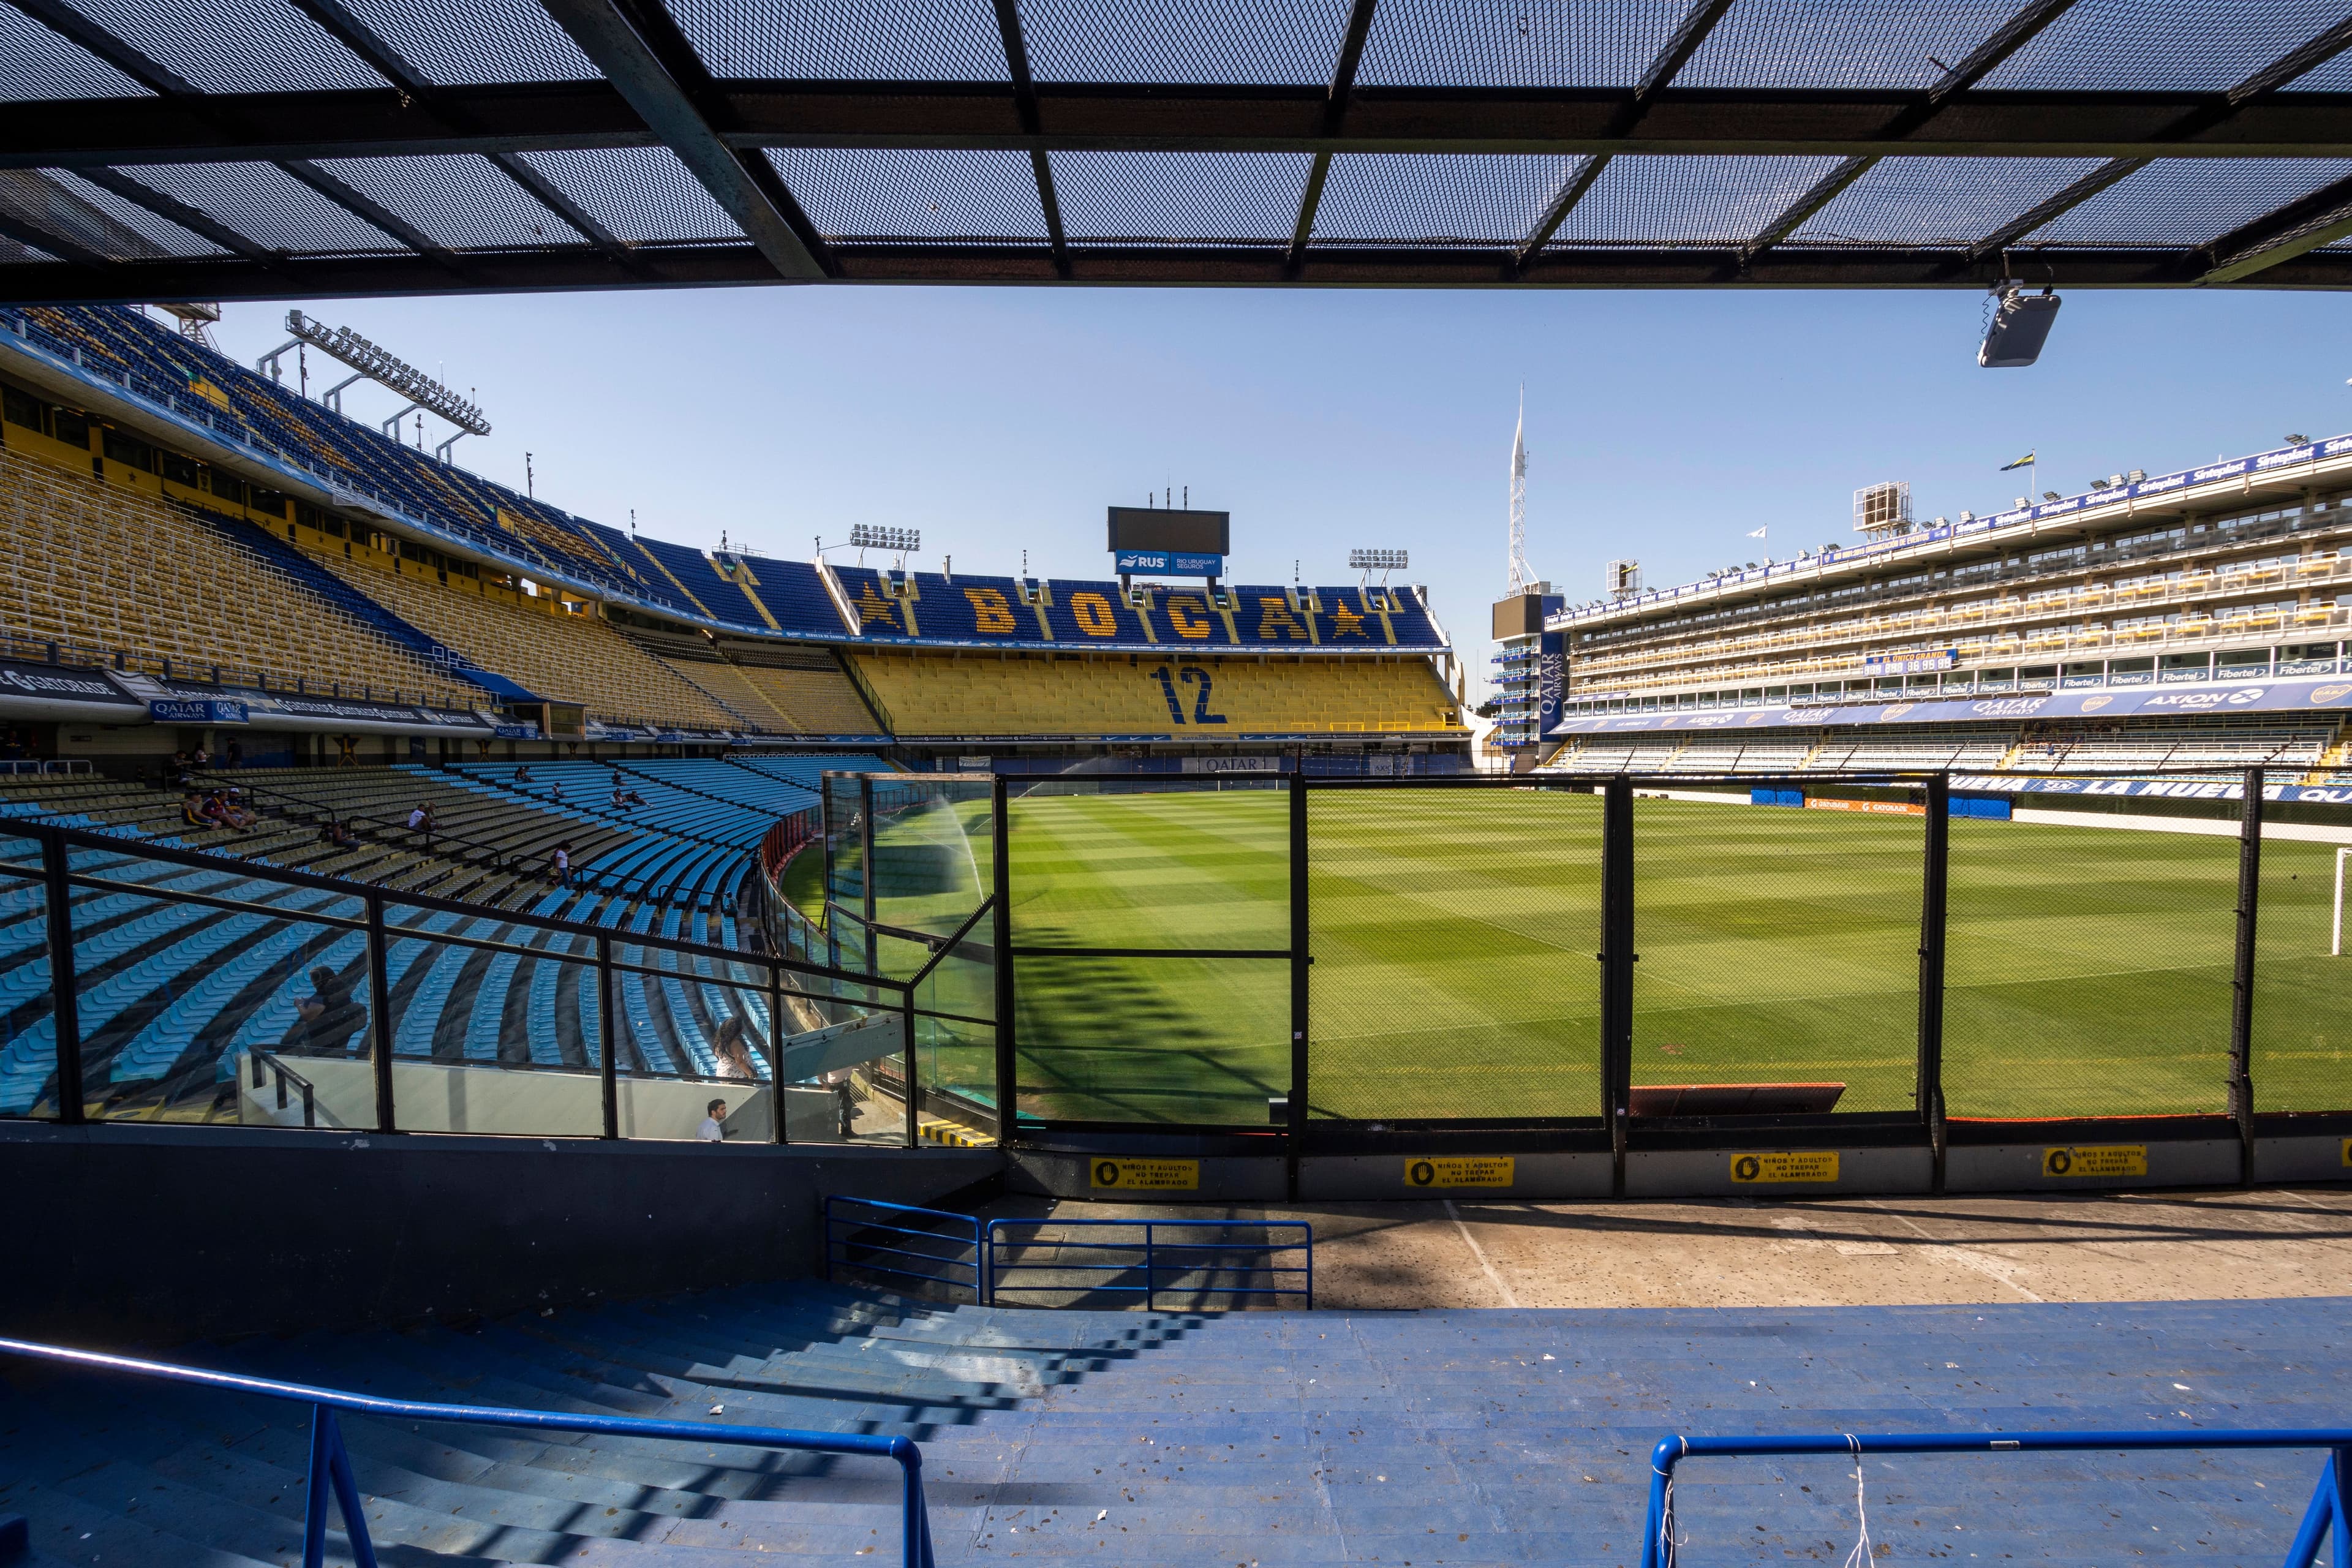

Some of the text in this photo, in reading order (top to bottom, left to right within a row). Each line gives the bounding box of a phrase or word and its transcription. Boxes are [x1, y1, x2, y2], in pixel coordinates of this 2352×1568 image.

[2255, 447, 2314, 467] Sinteplast
[2193, 461, 2246, 481] Sinteplast
[2137, 475, 2185, 494] Sinteplast
[2085, 488, 2129, 505] Sinteplast
[2039, 499, 2079, 515] Sinteplast
[1995, 509, 2032, 525] Sinteplast
[1956, 519, 1989, 535] Sinteplast
[1907, 532, 1929, 544] EVENTOS
[1915, 650, 1948, 660] GRANDE
[1553, 653, 1562, 699] AIRWAYS
[2218, 668, 2256, 678] Fibertel
[2280, 664, 2323, 675] Fibertel
[1540, 653, 1556, 714] QATAR
[2065, 678, 2095, 687] Fibertel
[2111, 675, 2143, 685] Fibertel
[2162, 672, 2198, 682] Fibertel
[24, 675, 118, 695] GATORADE
[2021, 681, 2048, 690] Fibertel
[1150, 666, 1228, 725] 12
[2143, 692, 2229, 706] AXION
[156, 703, 205, 714] QATAR
[285, 701, 330, 712] GATORADE
[380, 710, 418, 719] GATORADE
[1972, 698, 2046, 712] QATAR
[1782, 709, 1834, 719] QATAR
[1207, 759, 1256, 772] QATAR
[1948, 777, 2029, 791] UEVA
[2081, 781, 2132, 794] LA
[1873, 804, 1908, 812] GATORADE
